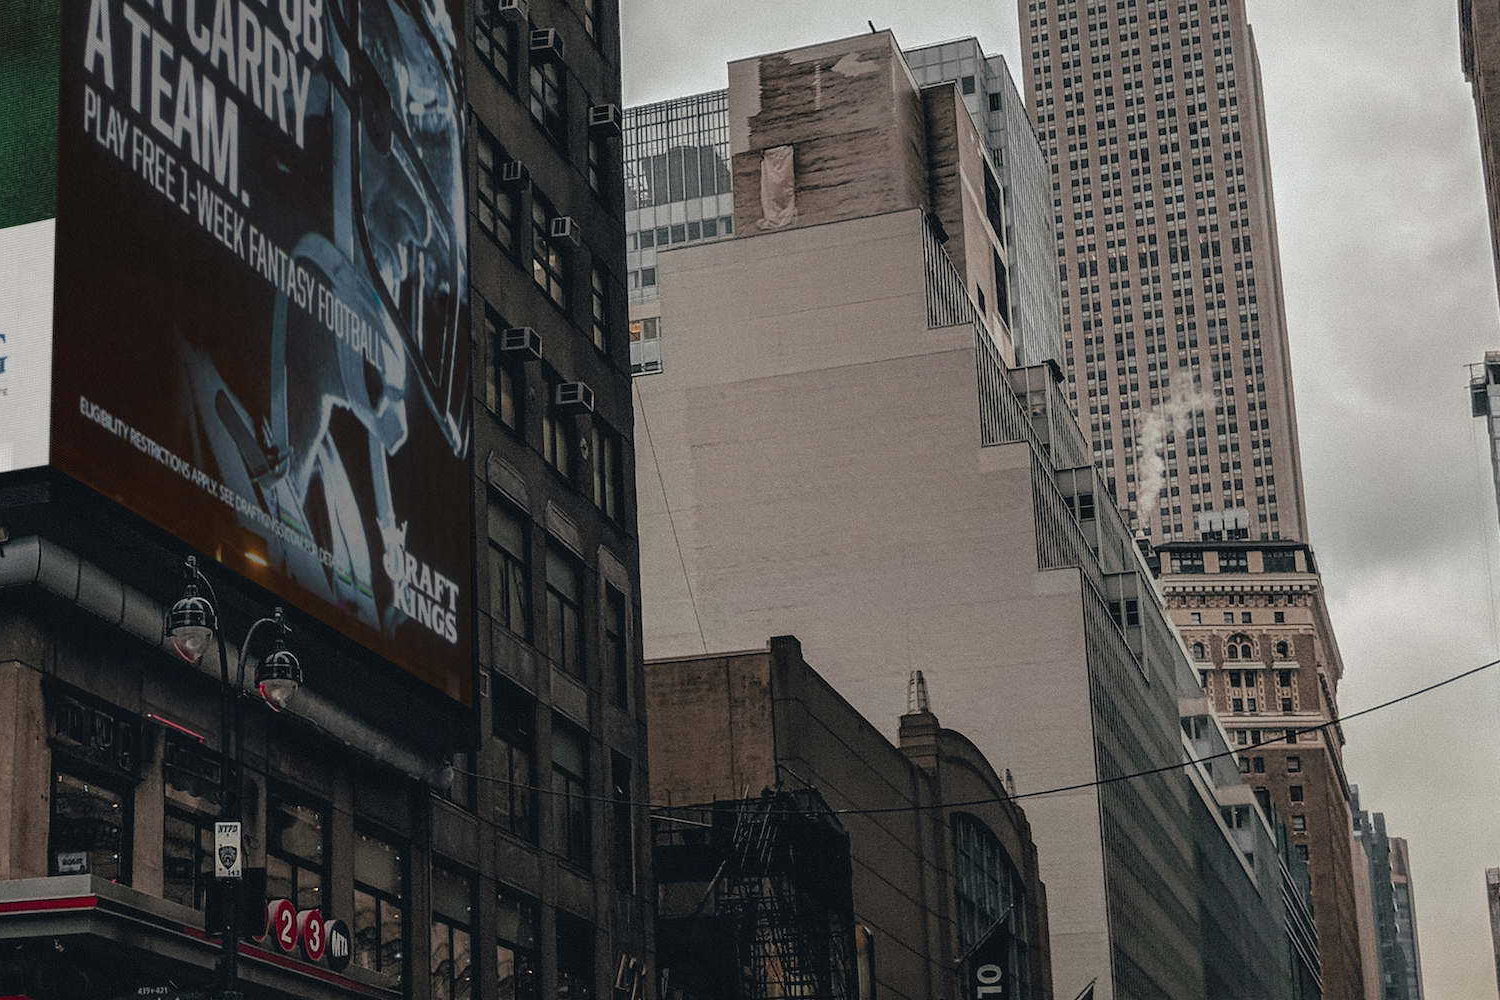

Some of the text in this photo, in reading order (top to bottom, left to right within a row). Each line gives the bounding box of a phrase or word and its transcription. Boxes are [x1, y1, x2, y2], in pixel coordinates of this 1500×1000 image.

[123, 2, 250, 208] TEAM.
[84, 84, 384, 374] PLAY FREE 1-WEEK FANTASY FOOTBALL
[80, 394, 129, 439] ELIGIBILITY
[130, 427, 191, 480] RESTRICTIONS
[191, 467, 218, 498] APPLY.
[219, 484, 234, 507] SEE
[383, 546, 460, 613] DRAFT
[393, 579, 458, 644] KINGS
[218, 825, 238, 833] NYPD
[281, 909, 349, 957] 2 3 MTA
